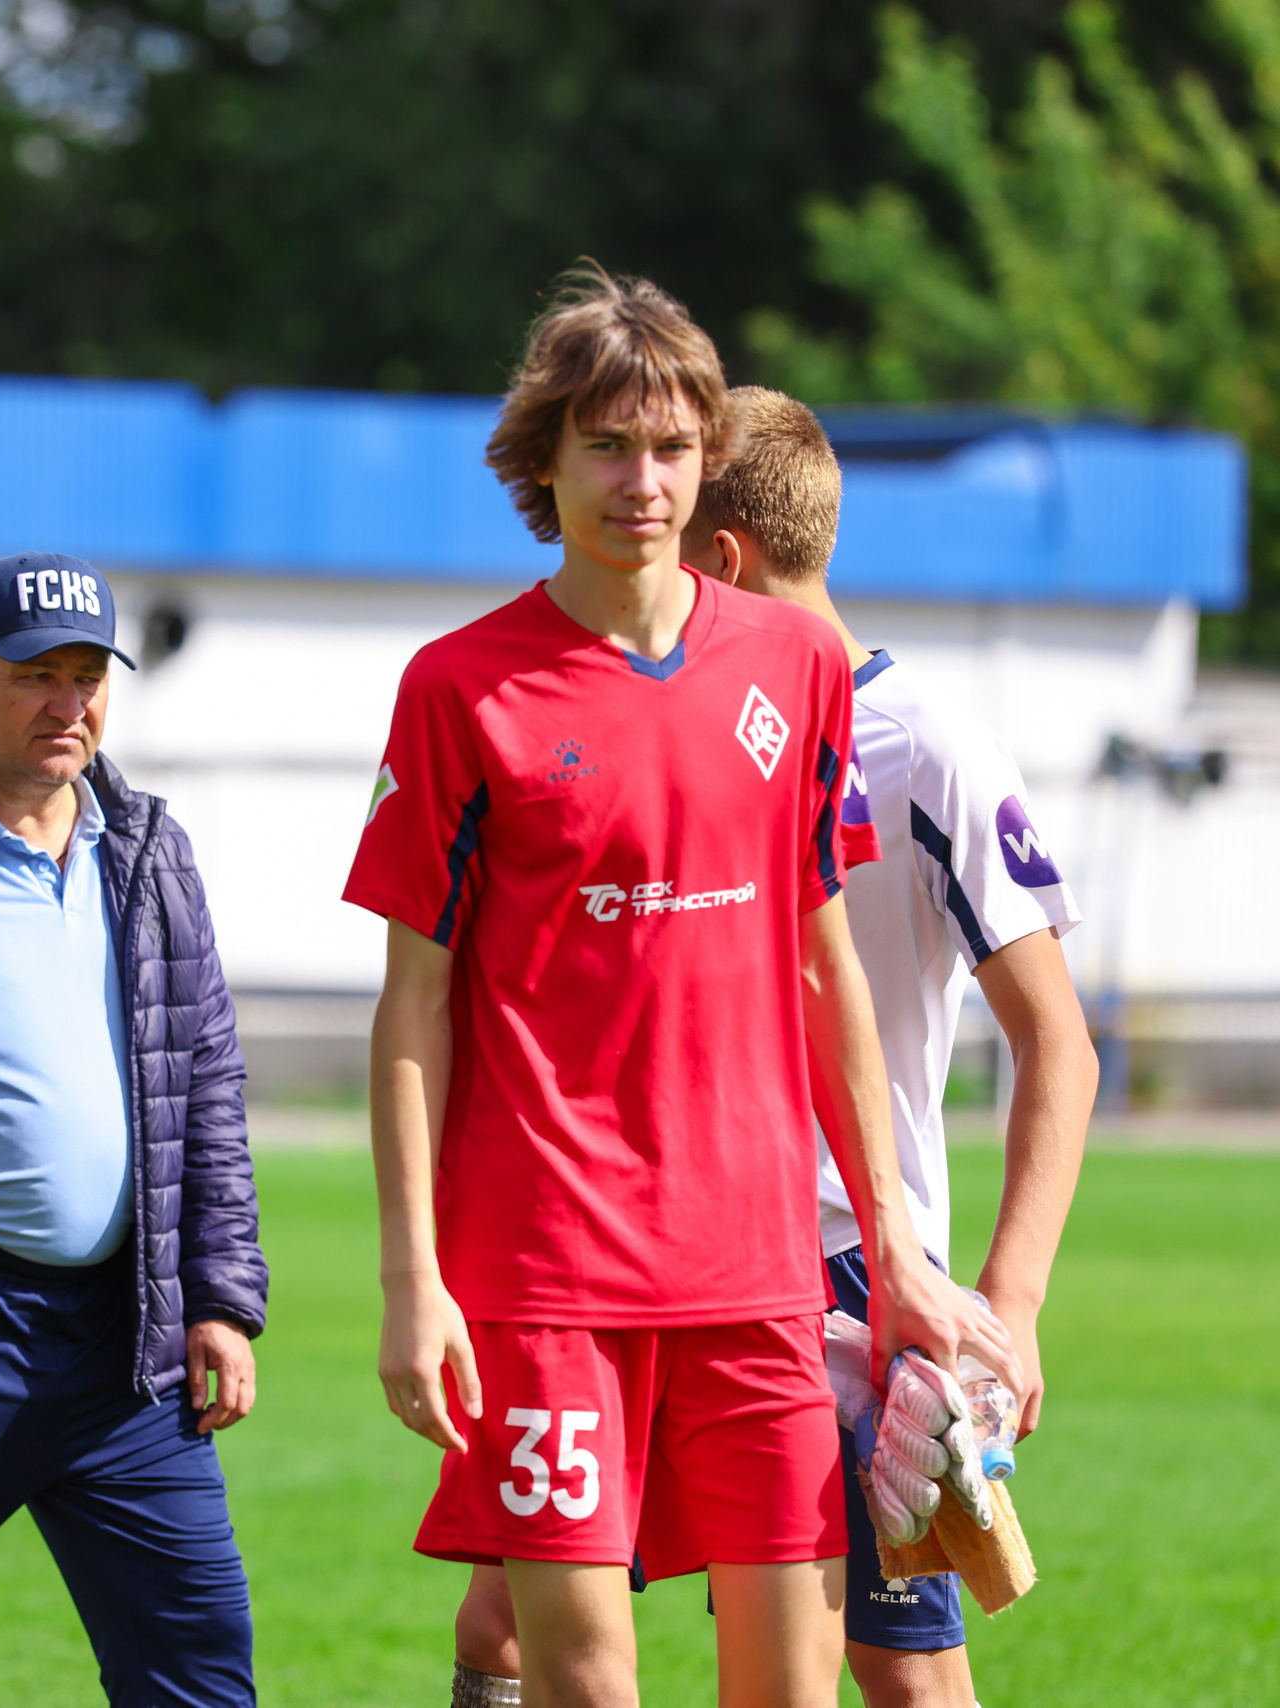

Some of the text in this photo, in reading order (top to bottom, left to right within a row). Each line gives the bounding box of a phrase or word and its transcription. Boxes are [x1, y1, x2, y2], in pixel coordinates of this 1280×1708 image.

[16, 569, 101, 617] FCKS
[631, 881, 756, 917] ТРАНССТРОЙ
[499, 1407, 600, 1520] 35
[869, 1591, 920, 1604] KELME
